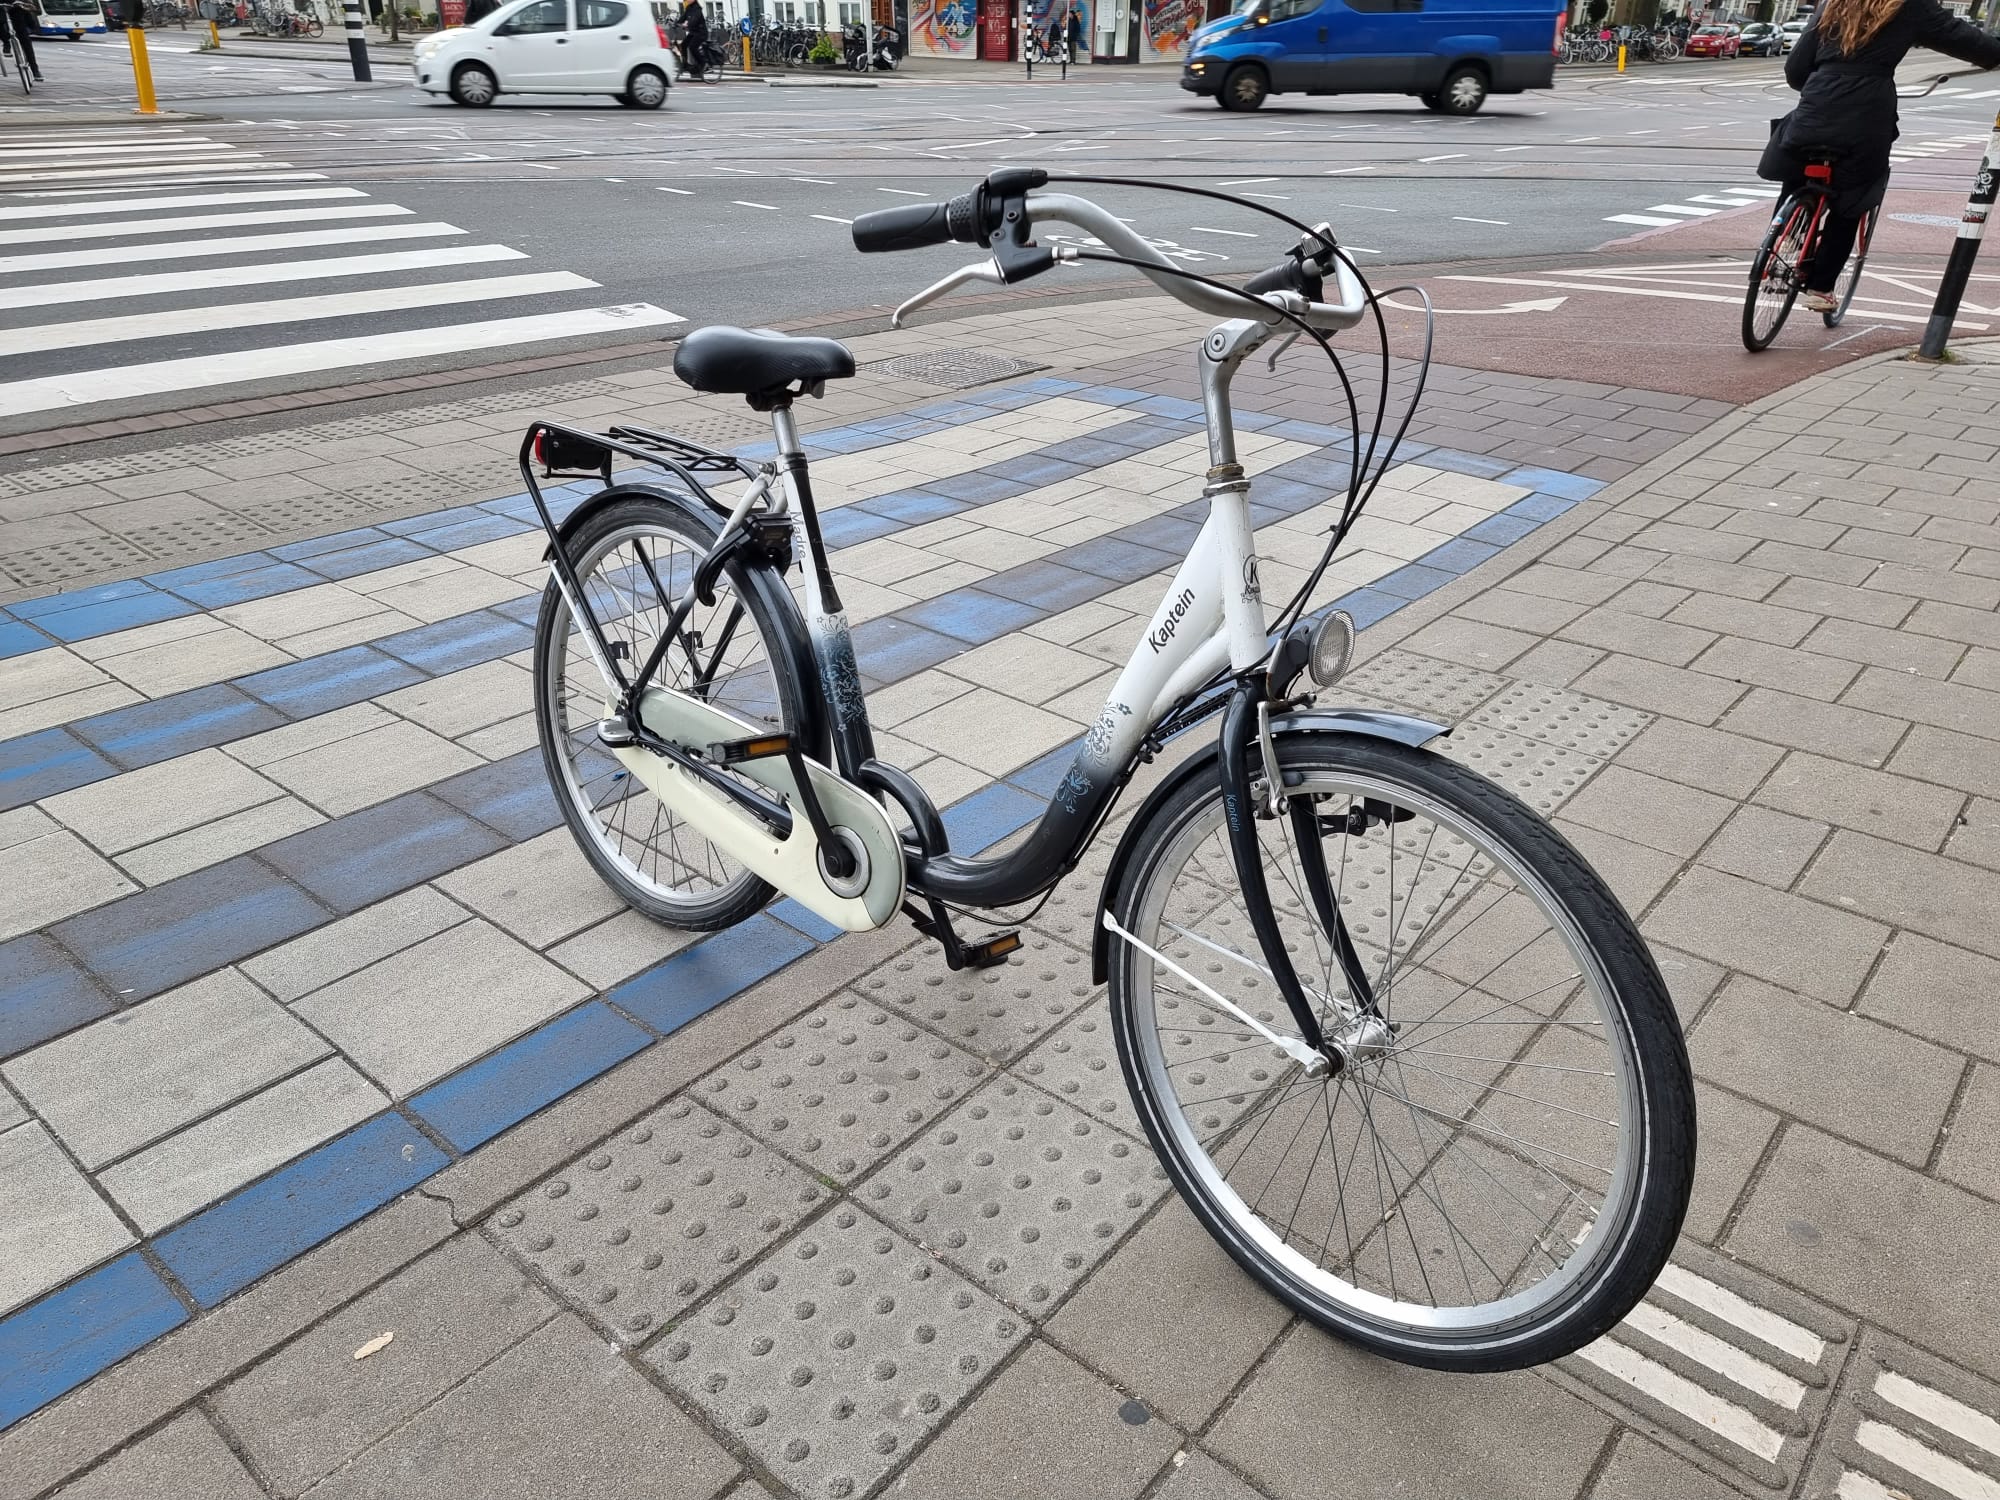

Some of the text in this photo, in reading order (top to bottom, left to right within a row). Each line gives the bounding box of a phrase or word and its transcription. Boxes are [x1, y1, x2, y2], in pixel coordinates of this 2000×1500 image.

[790, 511, 807, 559] Madre
[1148, 587, 1196, 654] Kaptein
[1225, 793, 1240, 833] Kaptein
